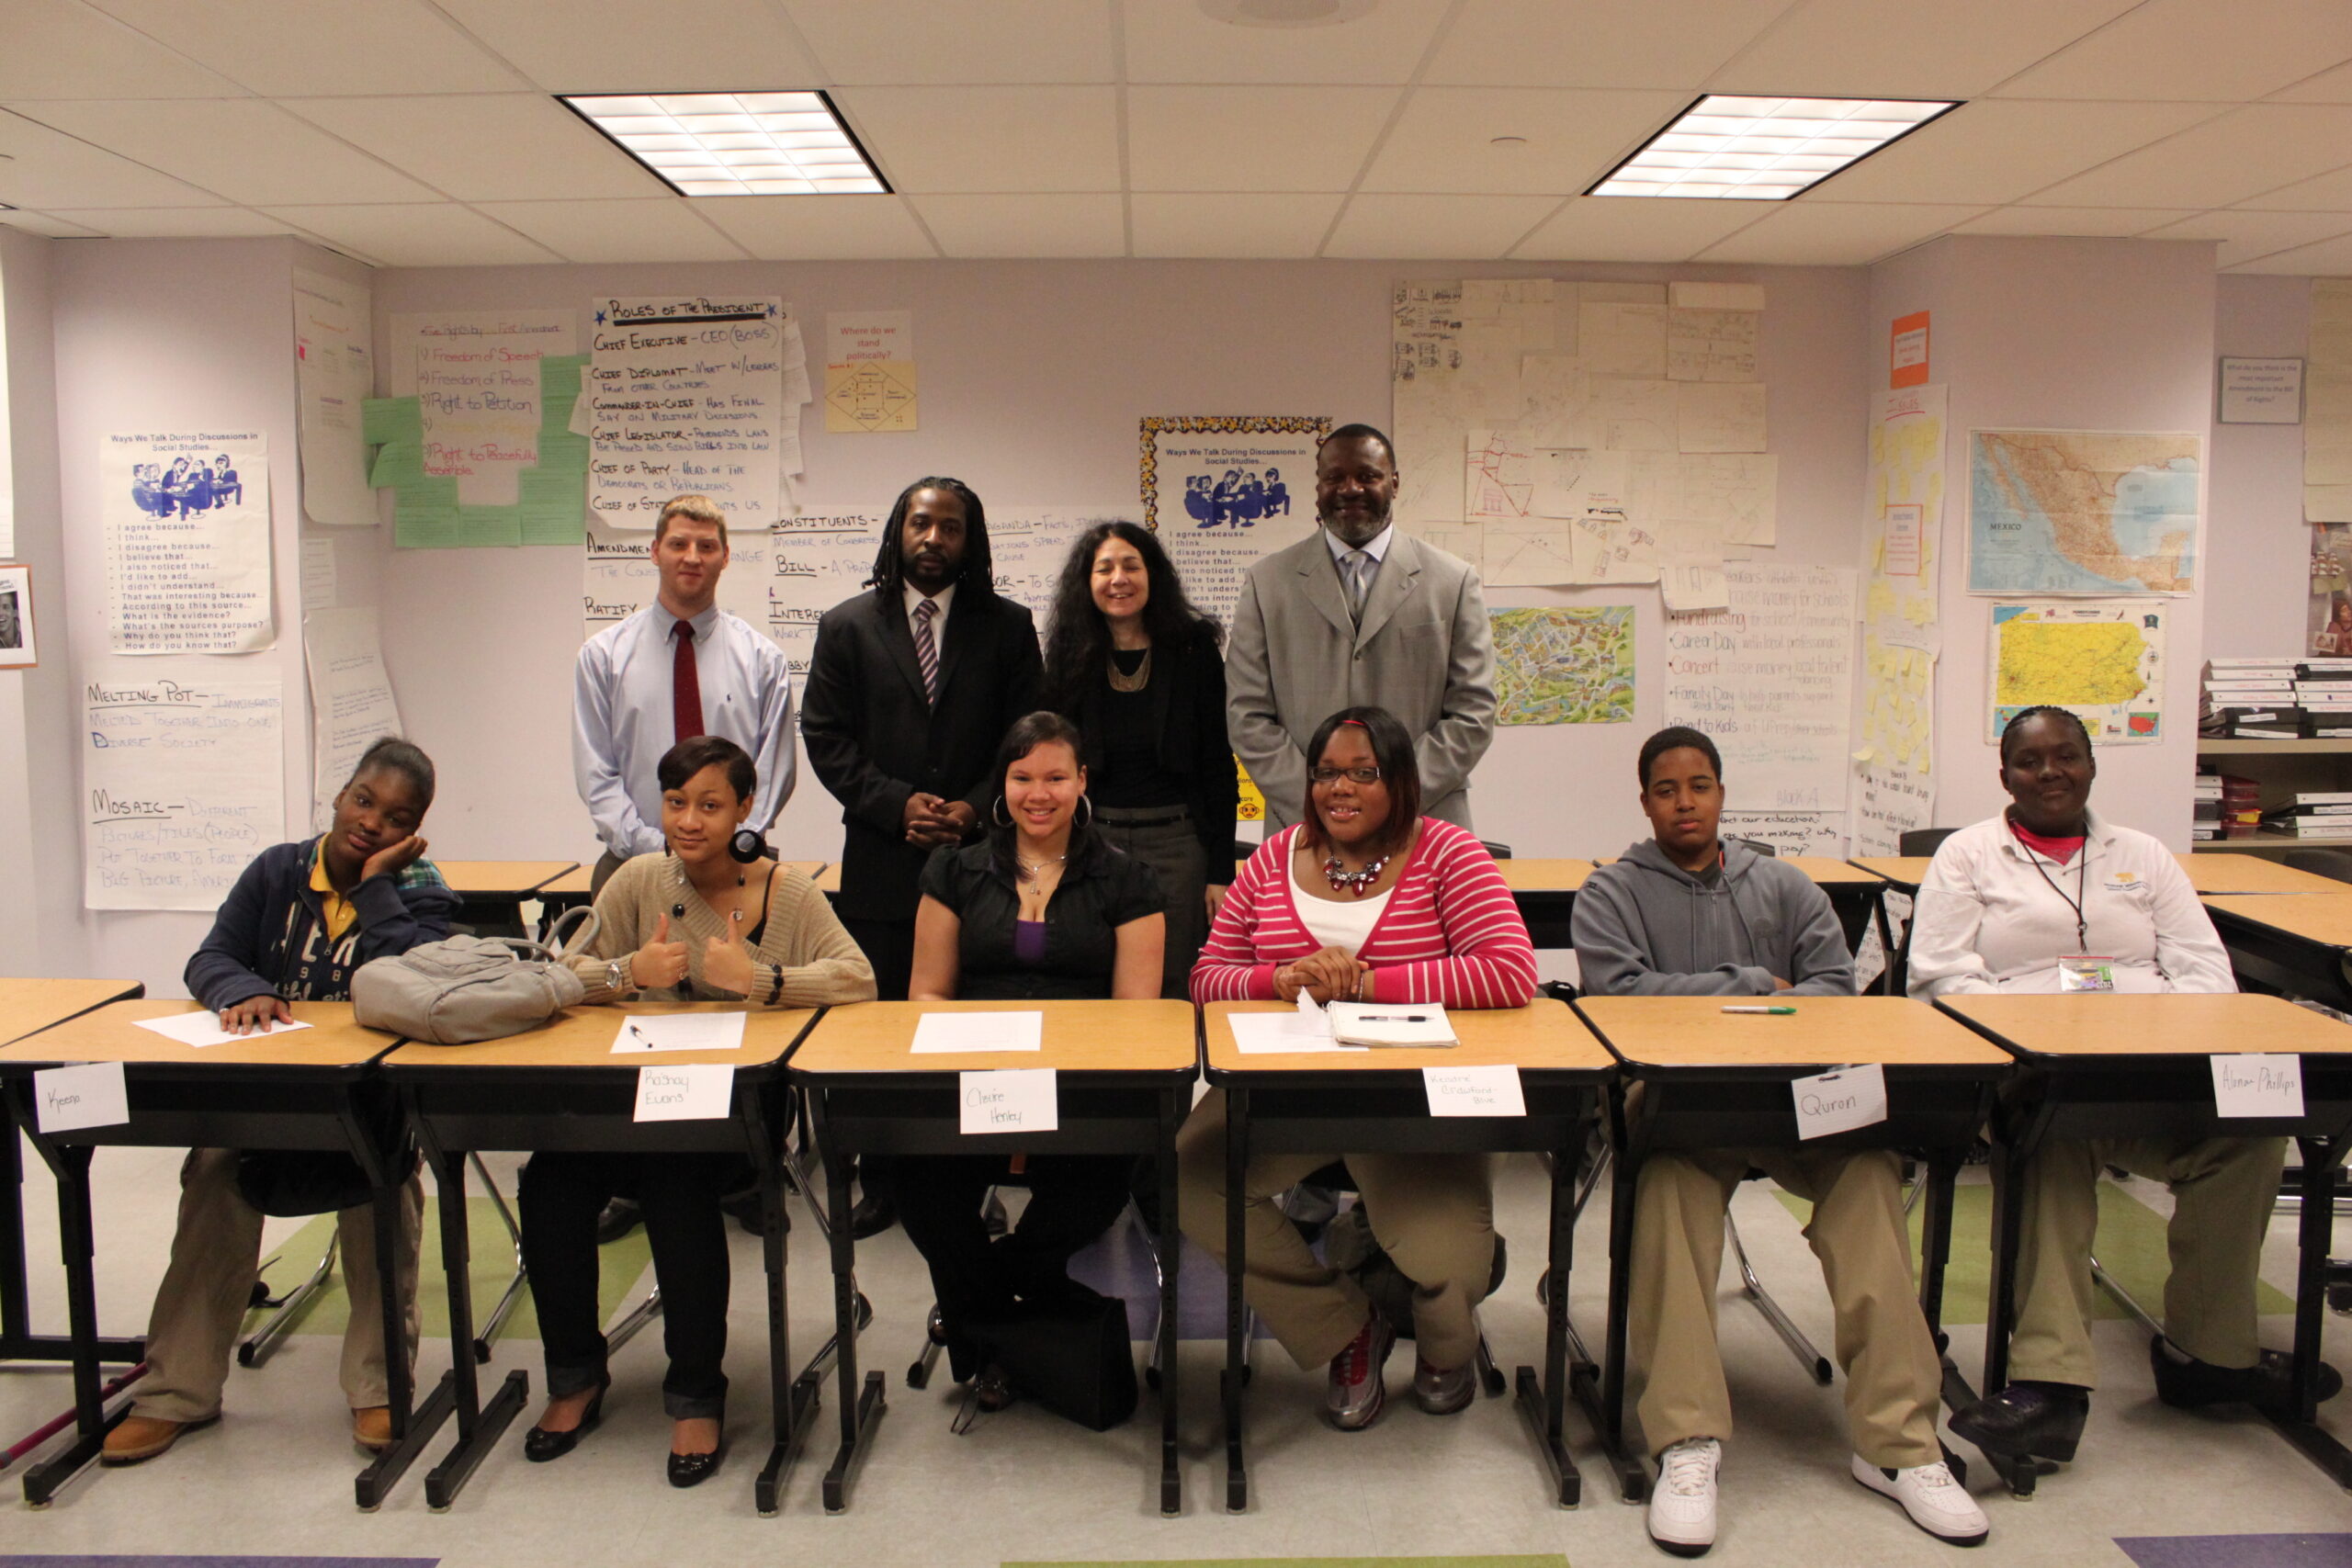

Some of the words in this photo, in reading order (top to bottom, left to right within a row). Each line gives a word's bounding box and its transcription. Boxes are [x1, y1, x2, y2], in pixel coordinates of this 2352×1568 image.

[609, 300, 655, 318] ROLES
[662, 307, 676, 315] OF
[697, 298, 764, 312] PRESIDENT
[857, 339, 880, 347] stand
[847, 351, 891, 360] politically?
[1166, 449, 1187, 457] Ways
[1222, 448, 1248, 457] During
[88, 683, 160, 703] MELTING
[93, 789, 164, 815] MOSAIC
[1744, 831, 1763, 840] you
[645, 1091, 684, 1105] Evans
[1802, 1094, 1856, 1116] Quron
